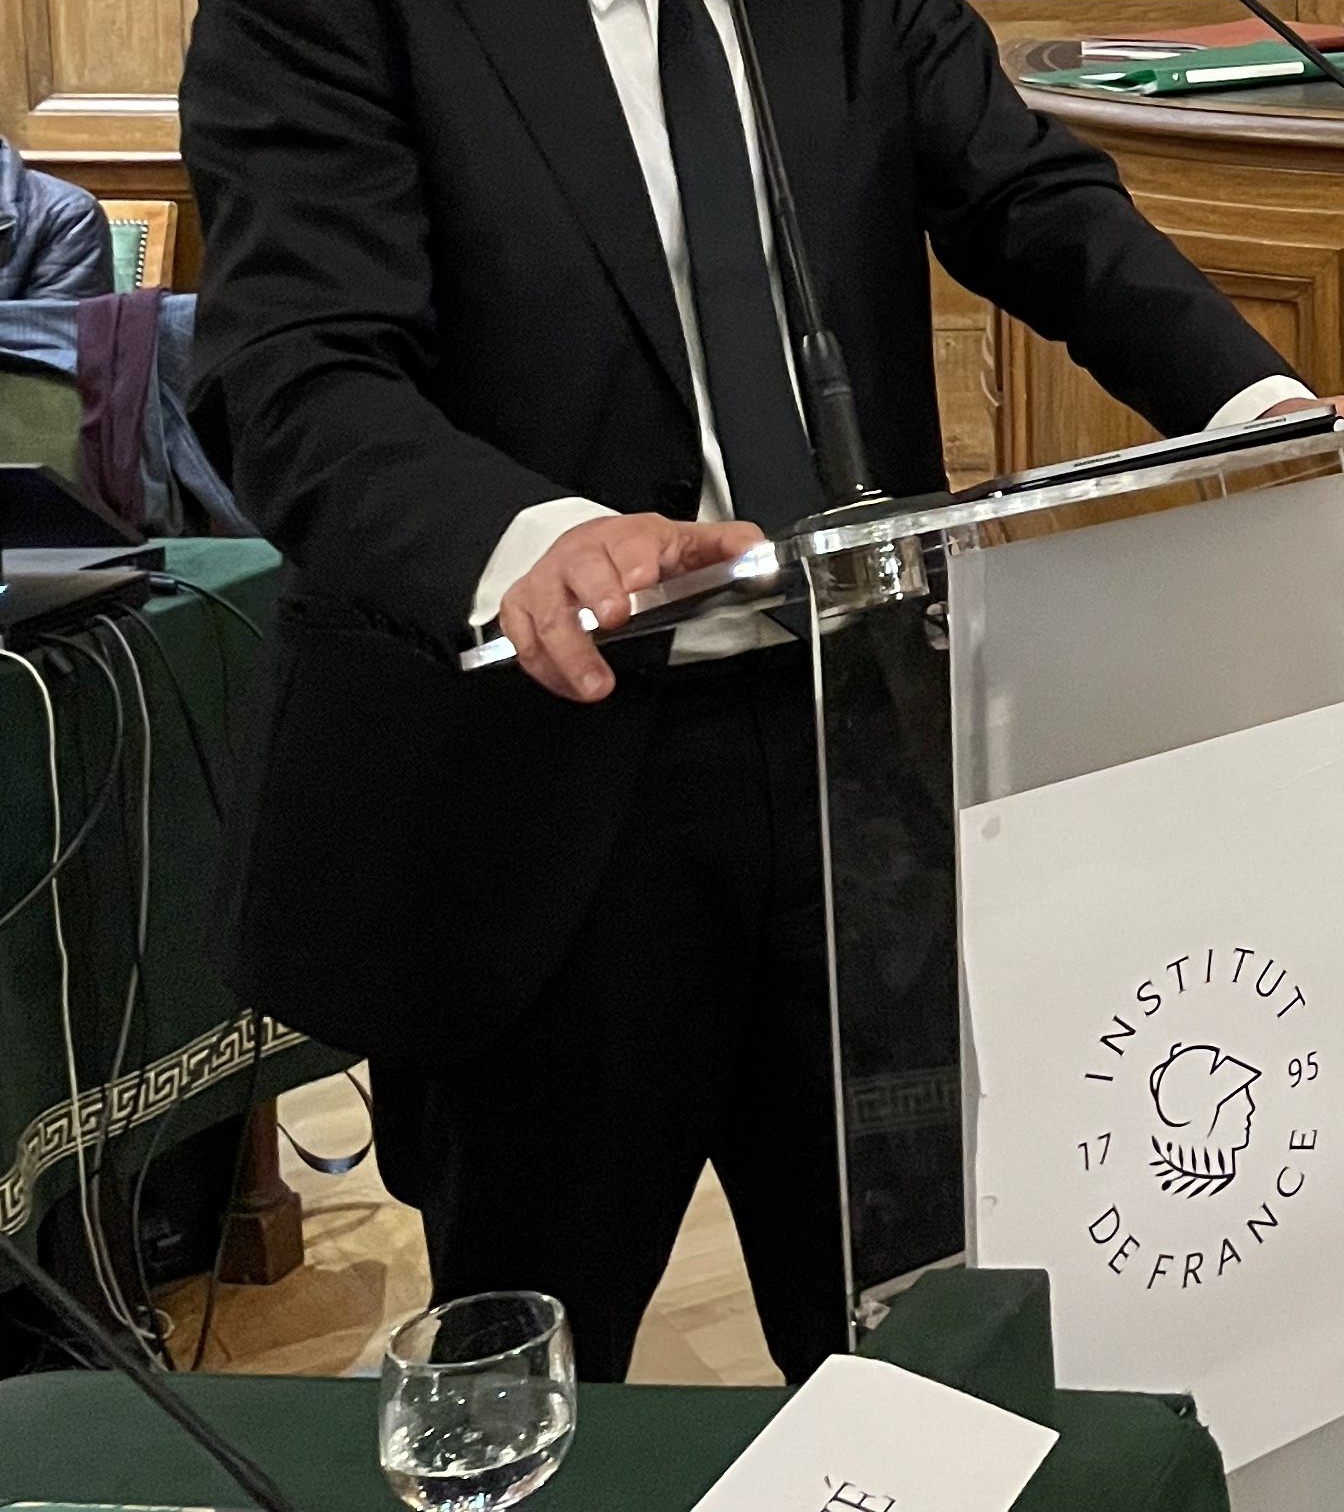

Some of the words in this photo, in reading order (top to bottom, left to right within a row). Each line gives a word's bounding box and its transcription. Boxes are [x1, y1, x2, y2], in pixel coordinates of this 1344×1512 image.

[1085, 947, 1306, 1082] INSTITUT
[1077, 1132, 1111, 1171] 17
[1288, 1050, 1319, 1088] 95
